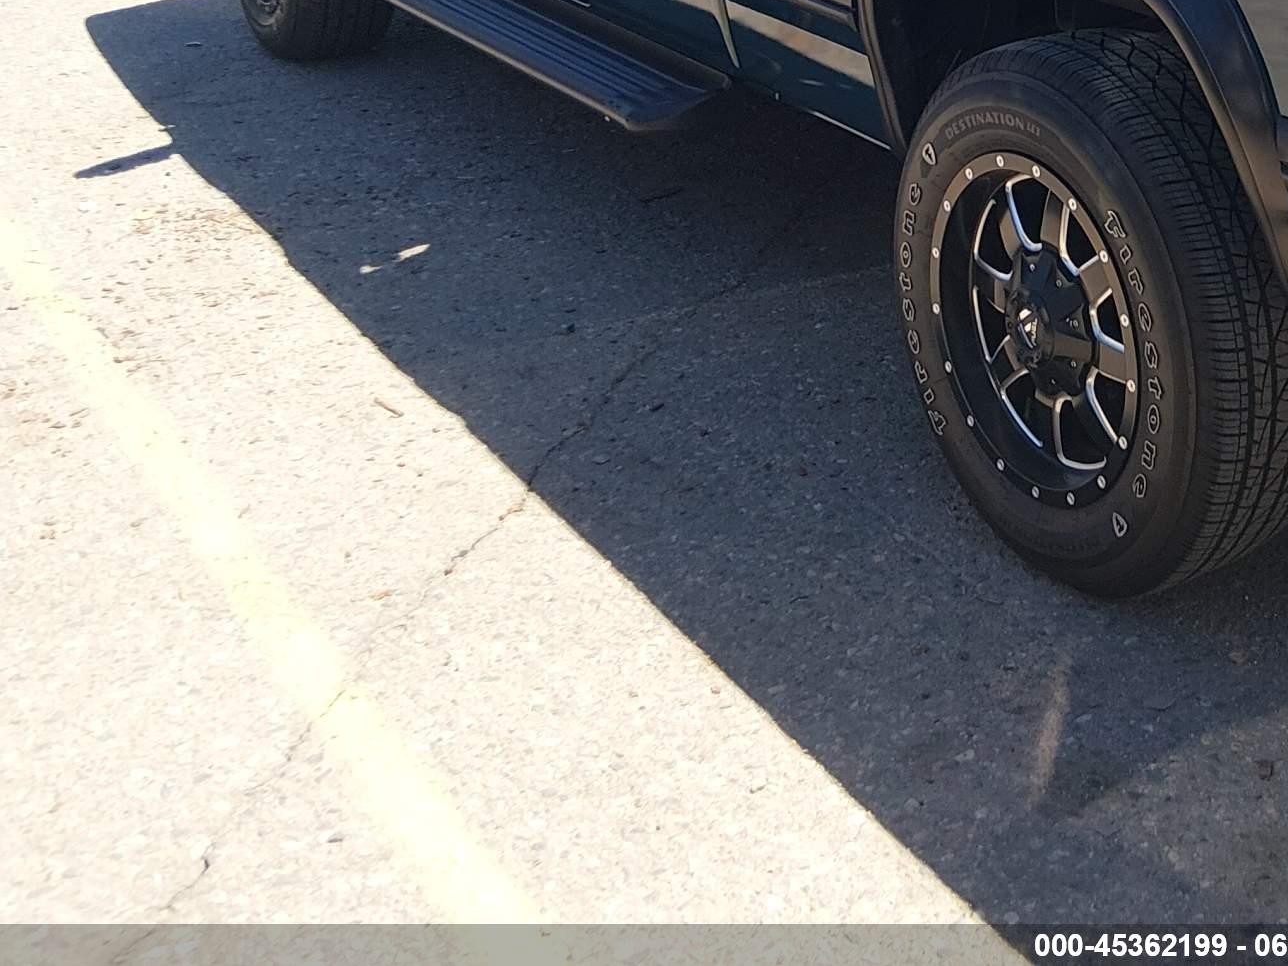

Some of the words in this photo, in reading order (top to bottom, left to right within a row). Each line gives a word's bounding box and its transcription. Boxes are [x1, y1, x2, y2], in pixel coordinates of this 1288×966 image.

[944, 111, 1025, 140] DESTINATION
[899, 182, 946, 436] Firestone
[1103, 209, 1163, 499] Firestone
